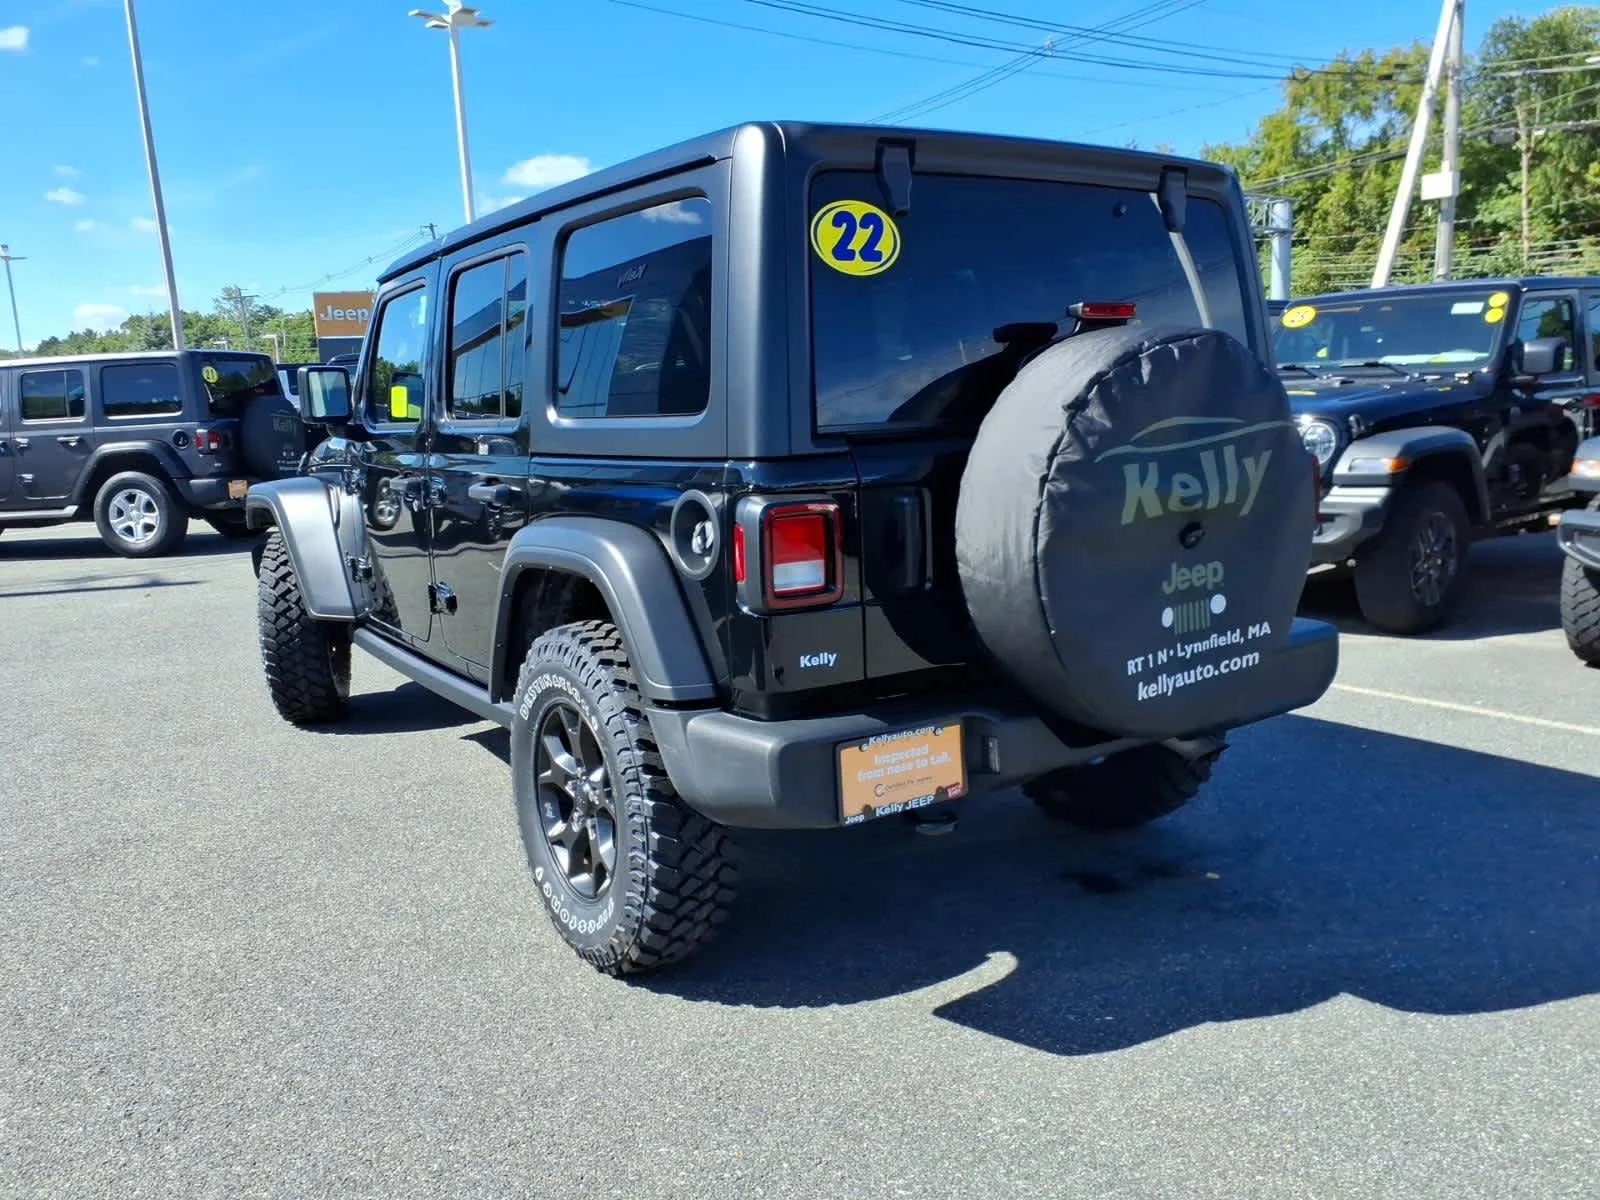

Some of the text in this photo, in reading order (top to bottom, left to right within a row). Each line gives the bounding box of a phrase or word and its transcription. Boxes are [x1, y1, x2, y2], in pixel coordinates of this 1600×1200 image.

[832, 210, 884, 262] 22
[320, 304, 369, 325] Jeep
[1120, 444, 1273, 526] Kelly
[1161, 559, 1225, 595] Jeep
[1127, 656, 1145, 676] RT
[1147, 653, 1153, 669] 1
[1177, 628, 1245, 659] Lynnfield,
[1247, 621, 1272, 640] MA
[799, 651, 837, 668] Kelly
[1137, 651, 1260, 701] kellyauto.com
[869, 726, 934, 744] Kellyauto.com
[915, 758, 928, 769] to
[875, 795, 935, 816] Kelly JEEP
[844, 814, 865, 825] Jeep
